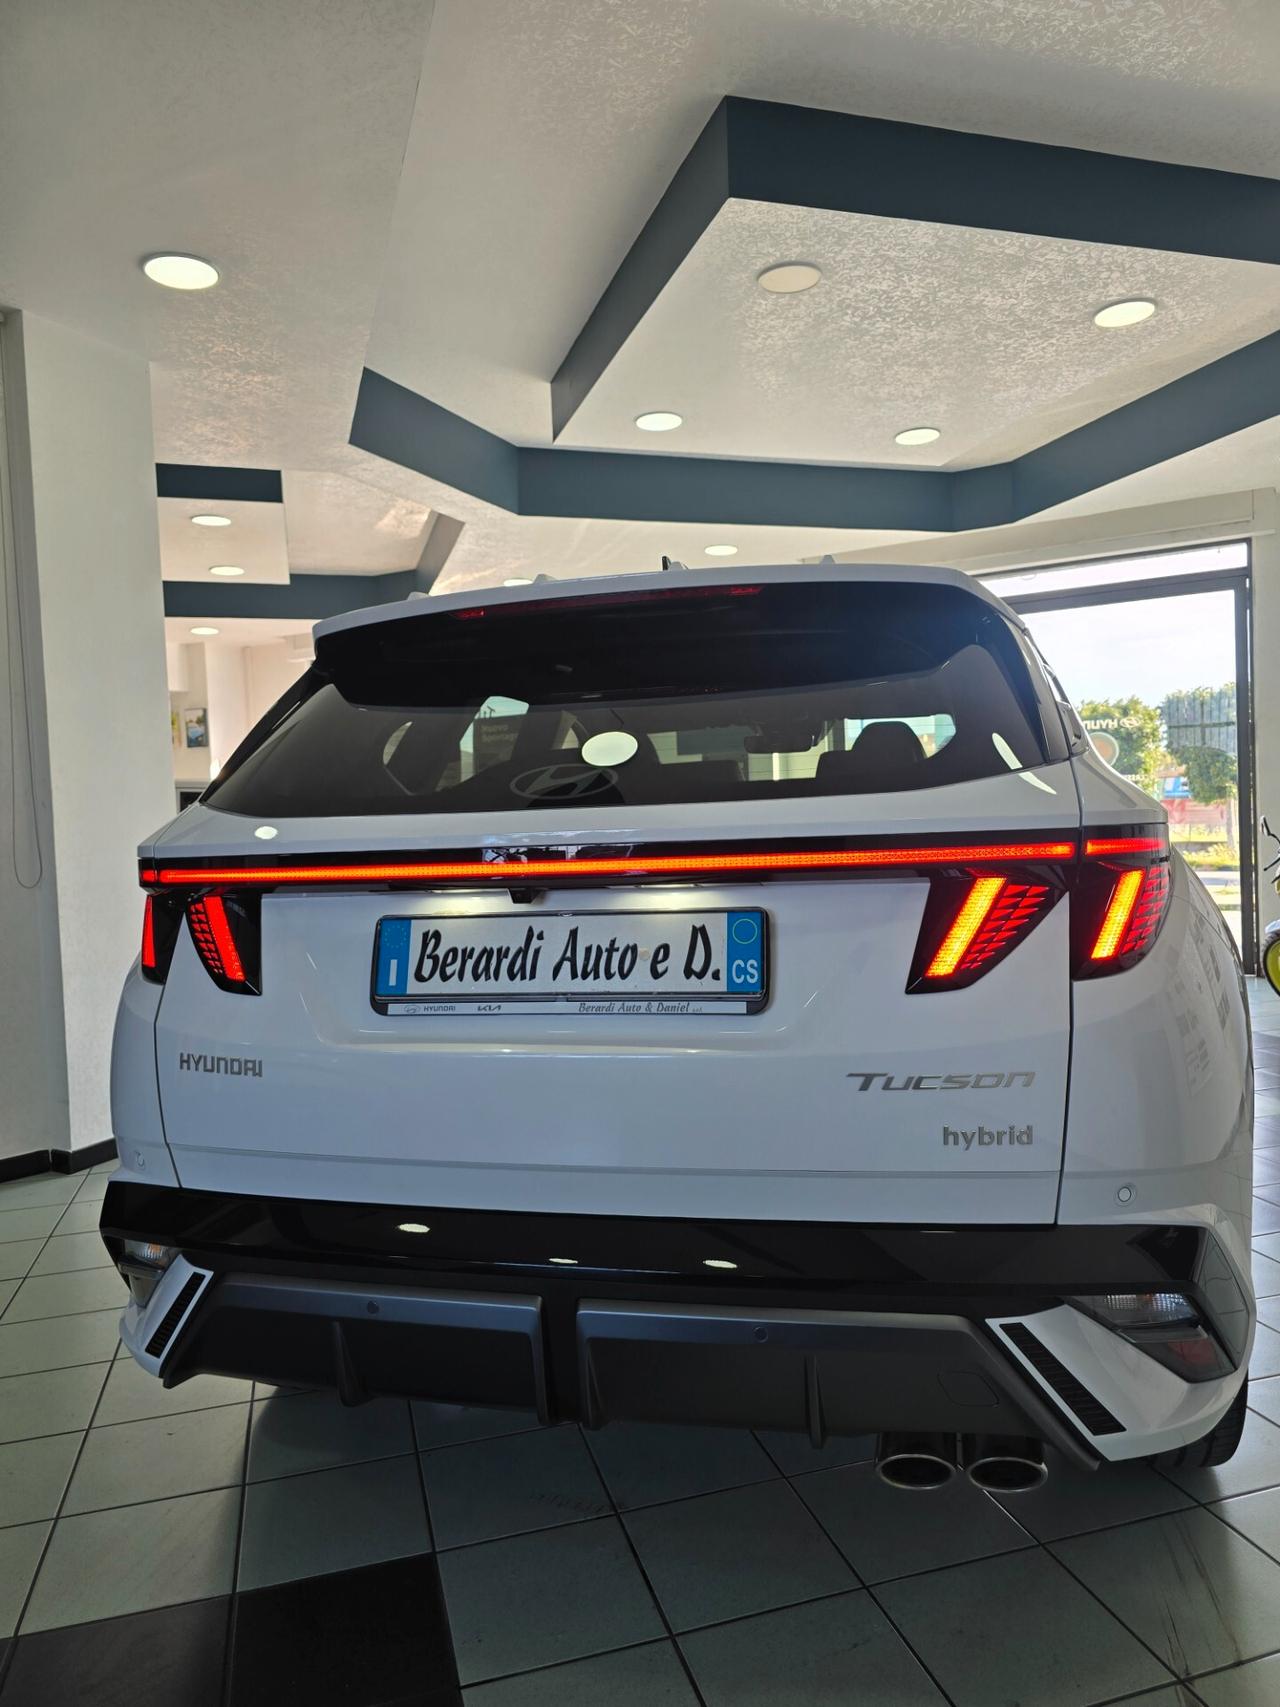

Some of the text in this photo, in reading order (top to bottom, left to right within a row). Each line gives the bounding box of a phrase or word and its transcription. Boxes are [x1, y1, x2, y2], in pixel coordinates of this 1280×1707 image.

[413, 923, 721, 983] Berardi Auto e D.
[732, 958, 759, 984] CS
[477, 1004, 502, 1012] KIA
[578, 1002, 616, 1013] Berardi
[617, 1002, 642, 1013] Auto
[644, 1002, 653, 1013] &
[656, 1001, 691, 1013] Daniel
[179, 1052, 263, 1077] HYUNDAI
[846, 1071, 1036, 1092] TUCSON
[942, 1125, 1034, 1150] hybrid
